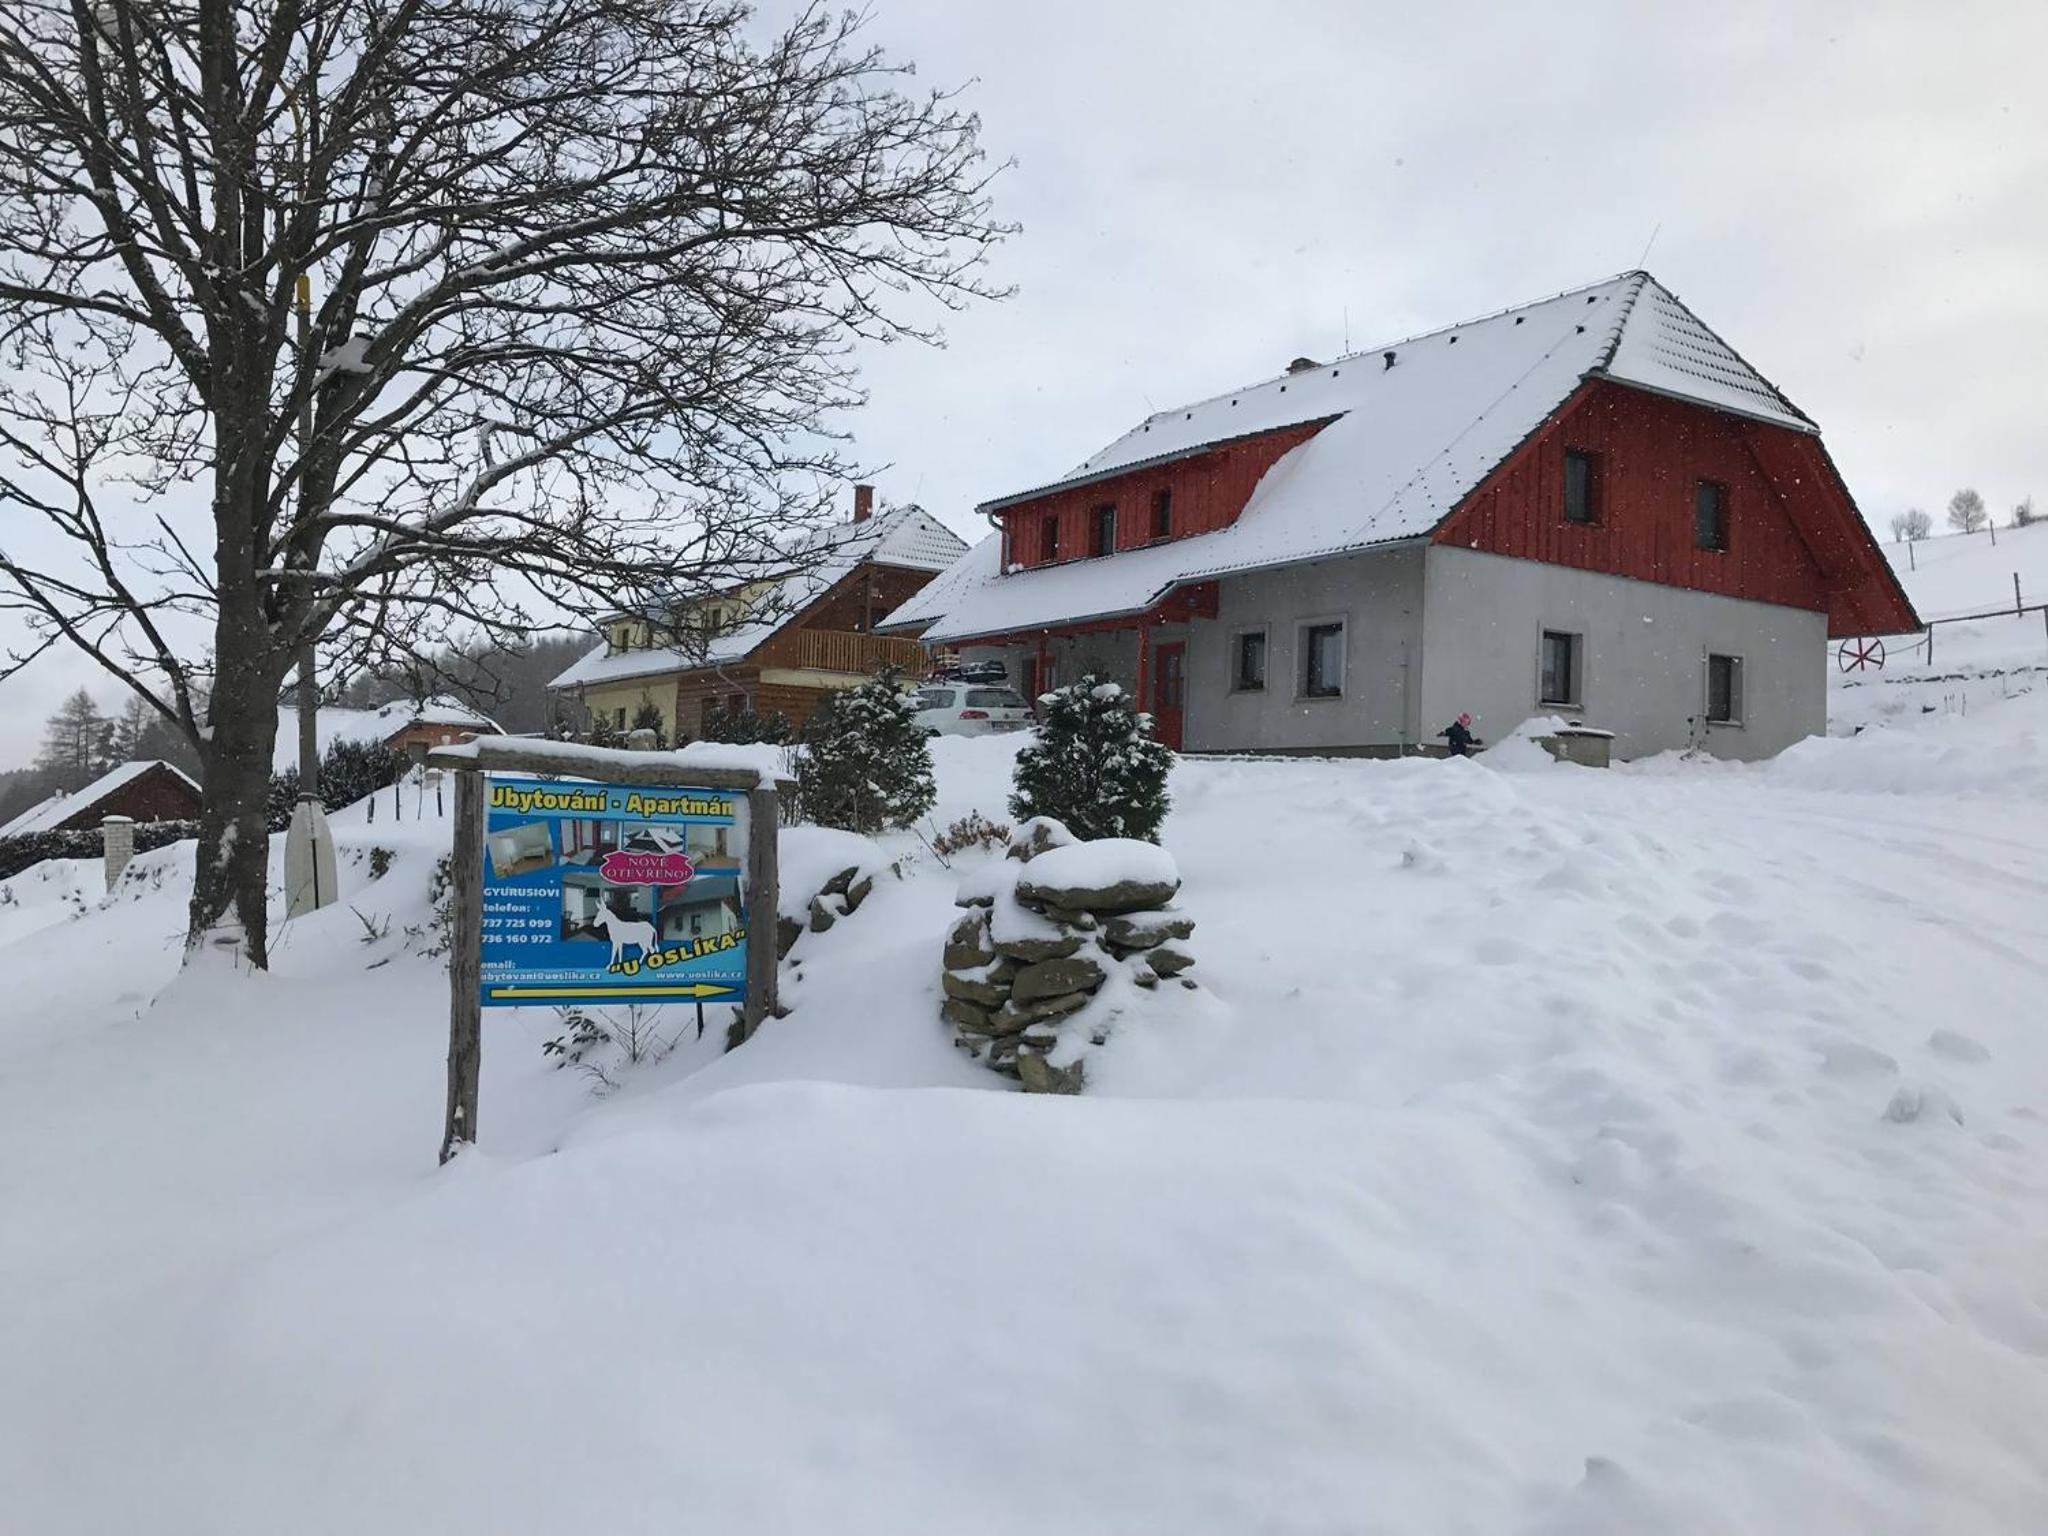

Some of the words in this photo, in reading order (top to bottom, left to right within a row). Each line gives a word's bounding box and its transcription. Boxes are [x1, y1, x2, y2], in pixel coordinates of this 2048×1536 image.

[489, 787, 607, 813] Ubytování
[626, 793, 735, 817] Apartmán
[482, 903, 531, 912] telefon:
[481, 918, 503, 928] 737
[505, 918, 526, 928] 725
[529, 919, 552, 928] 099
[480, 934, 503, 943] 736
[506, 934, 527, 943] 160
[531, 934, 553, 944] 972
[480, 959, 516, 969] email:
[656, 970, 742, 979] www.uoslika.cz
